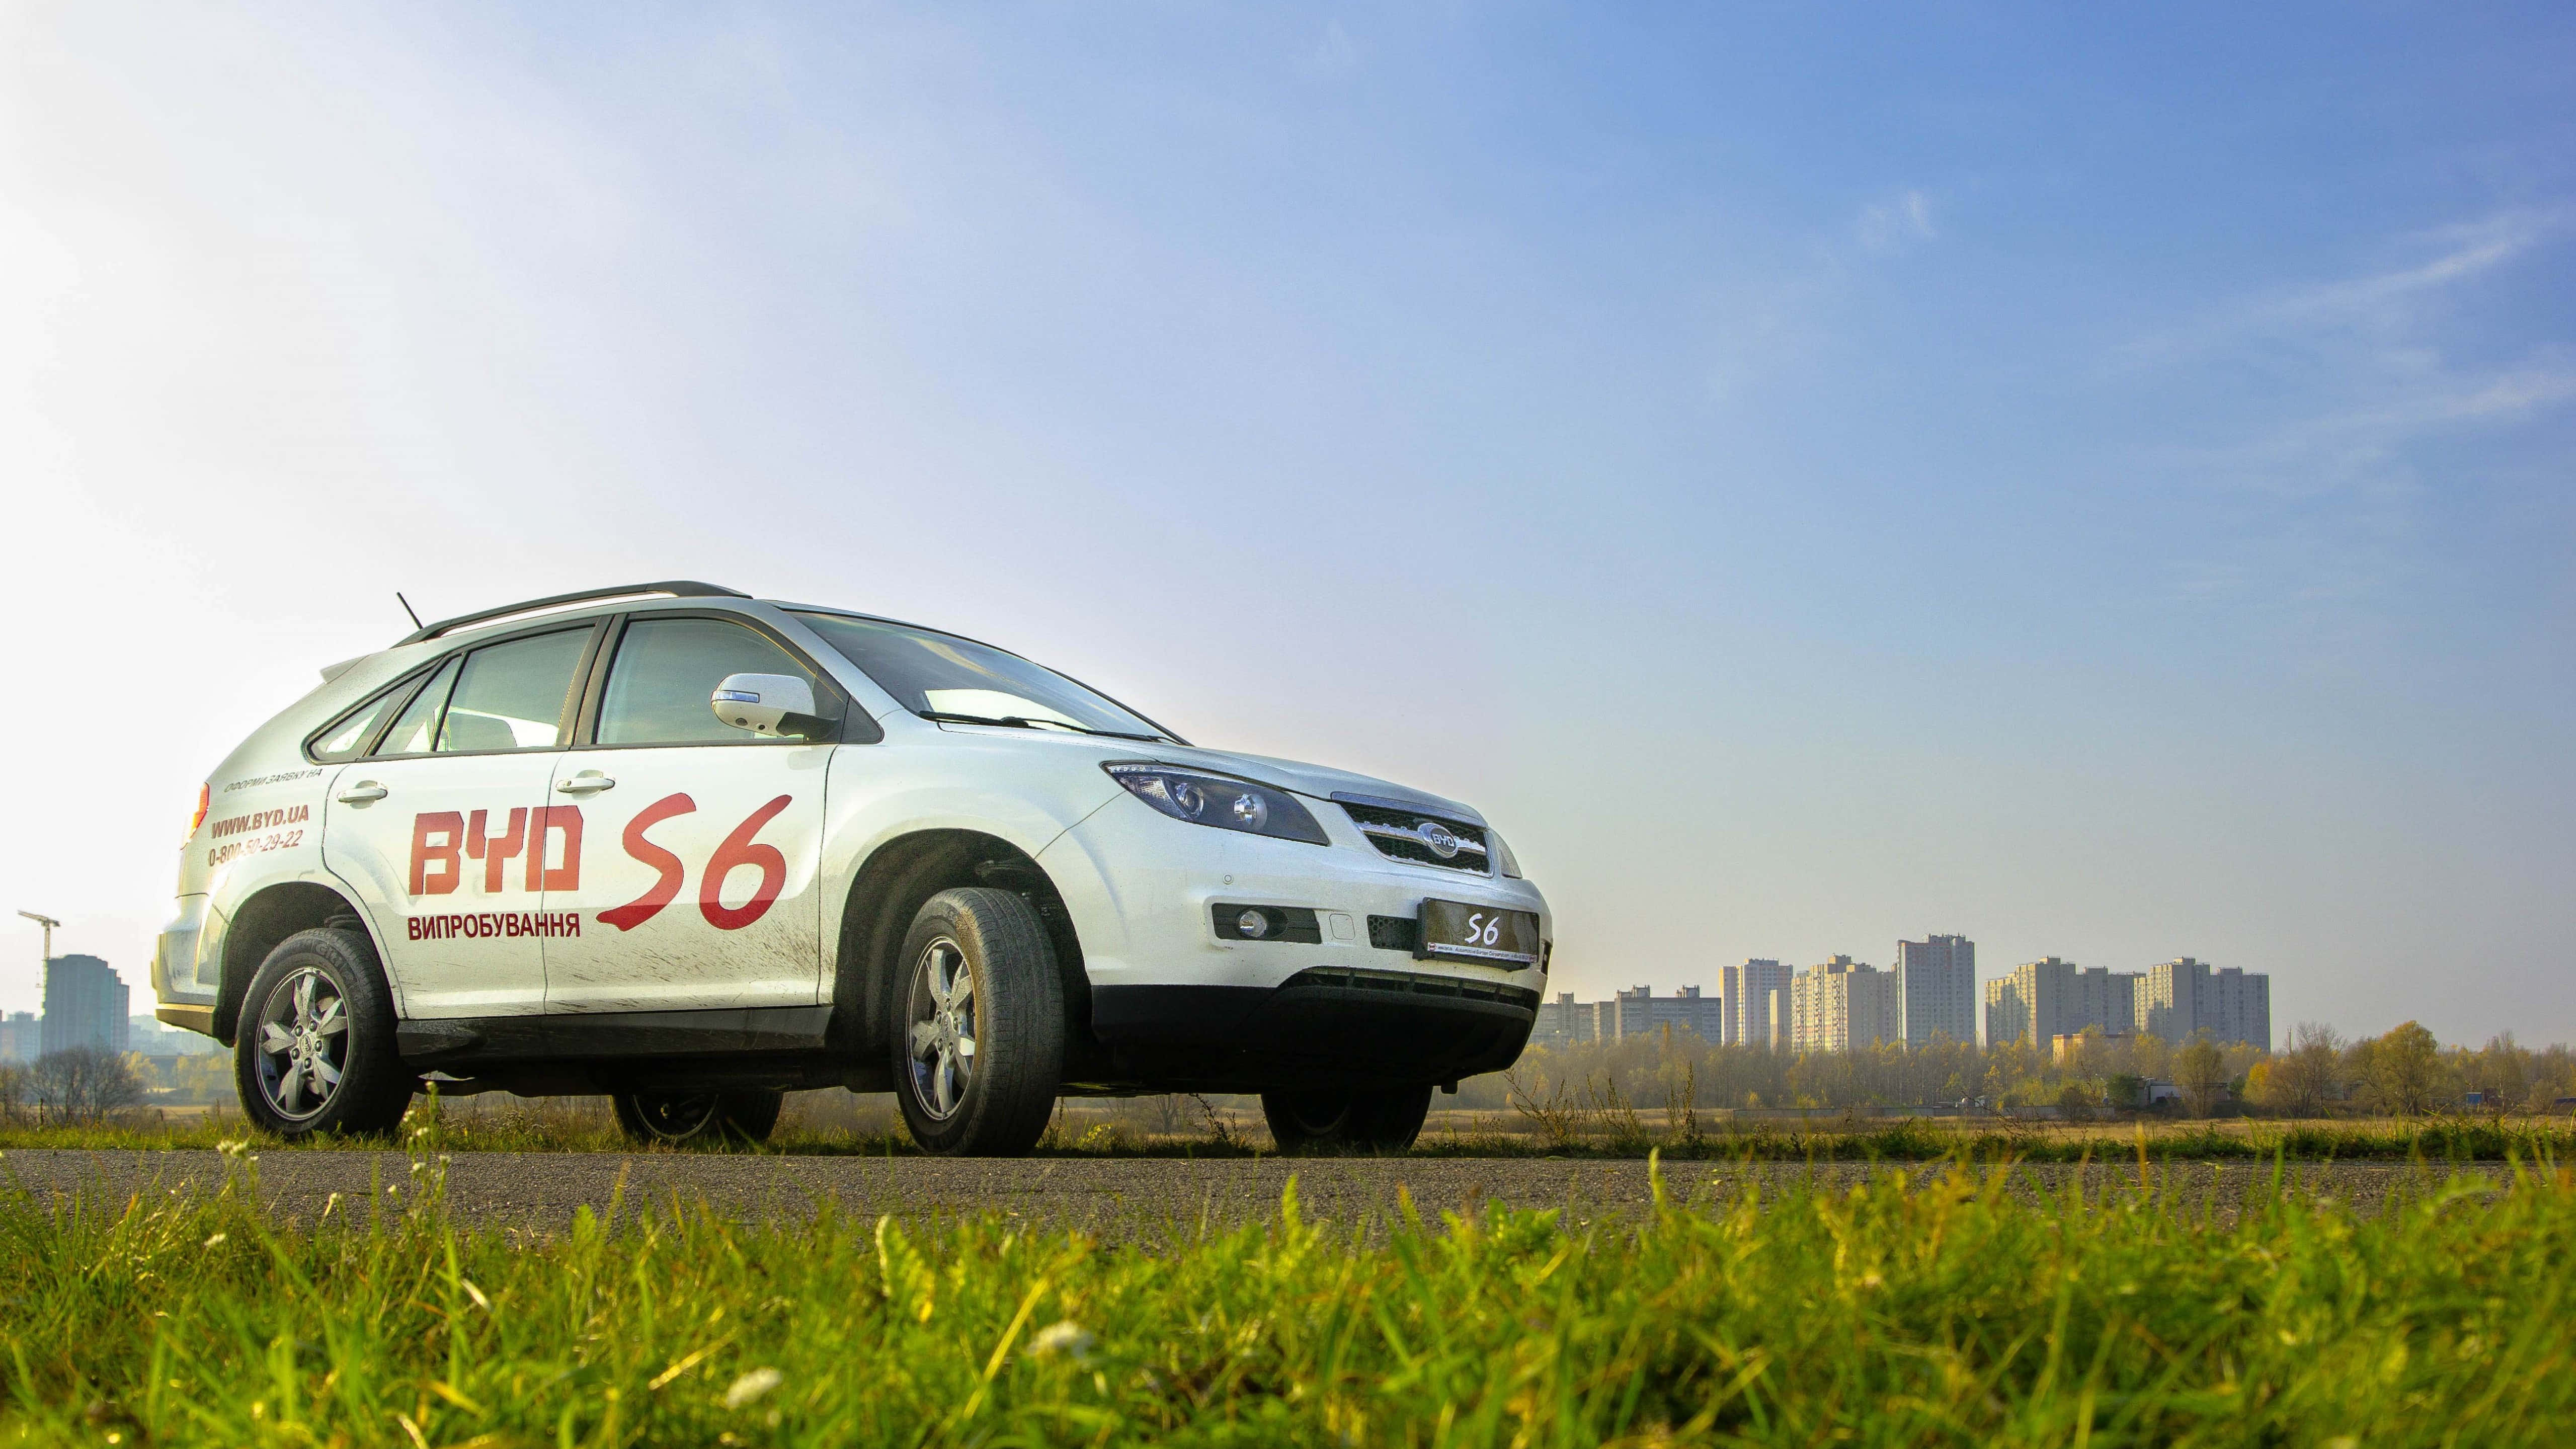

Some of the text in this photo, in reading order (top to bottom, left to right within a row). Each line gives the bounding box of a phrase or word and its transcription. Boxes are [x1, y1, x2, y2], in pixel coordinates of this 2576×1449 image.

[306, 768, 323, 778] НА
[212, 804, 308, 839] WWW.BYD.UA
[1432, 833, 1455, 847] BYD
[409, 792, 792, 931] BYD S6
[408, 912, 581, 940] ВИПРОБУВАННЯ
[1465, 913, 1500, 946] S6
